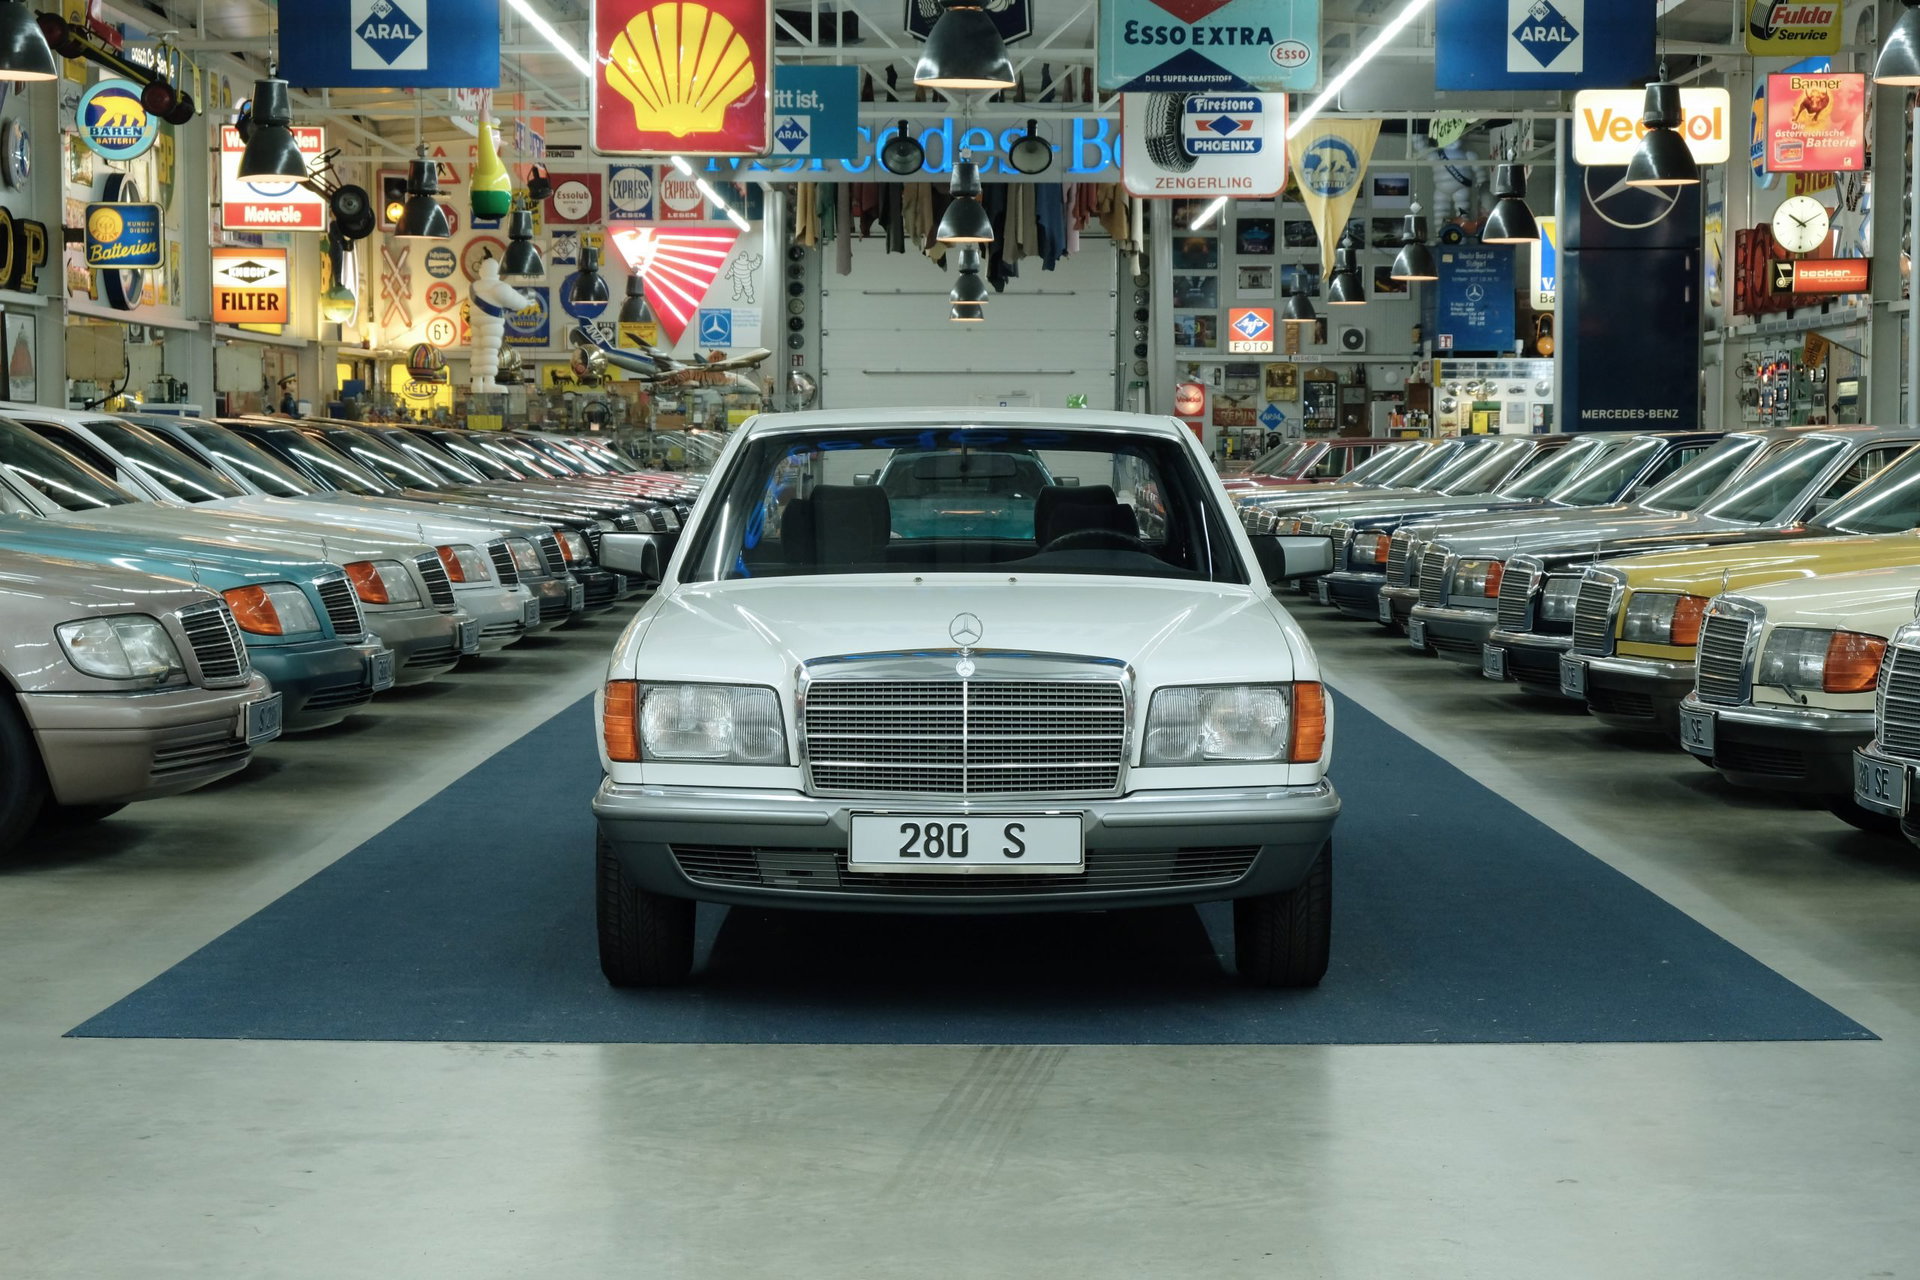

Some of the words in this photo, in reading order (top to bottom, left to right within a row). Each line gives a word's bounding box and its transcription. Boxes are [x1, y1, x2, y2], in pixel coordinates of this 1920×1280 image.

[1771, 3, 1833, 25] Fulda
[364, 24, 415, 39] ARAL
[1192, 27, 1275, 45] EXTRA
[1520, 26, 1572, 42] ARAL
[1778, 29, 1828, 40] Service
[1791, 77, 1841, 90] Banner
[796, 90, 824, 112] ist,
[1193, 98, 1254, 112] Firestone
[96, 137, 137, 145] BATTERIE
[778, 130, 805, 139] ARAL
[1775, 129, 1845, 138] österreichische
[1194, 140, 1255, 151] PHOENIX
[1806, 137, 1857, 148] Batterie
[613, 179, 649, 199] EXPRESS
[664, 179, 700, 199] EXPRESS
[1155, 177, 1253, 189] ZENGERLING
[556, 191, 590, 200] Essolub
[244, 205, 302, 223] Motoröle
[89, 239, 157, 262] Batterien
[229, 267, 270, 278] KNECHT
[221, 292, 279, 311] FILTER
[433, 291, 439, 305] 2
[434, 324, 441, 340] 6
[583, 325, 604, 345] ANA
[1234, 342, 1269, 351] FOTO
[1875, 767, 1890, 800] SE
[899, 822, 969, 858] 280
[1003, 822, 1026, 858] S
